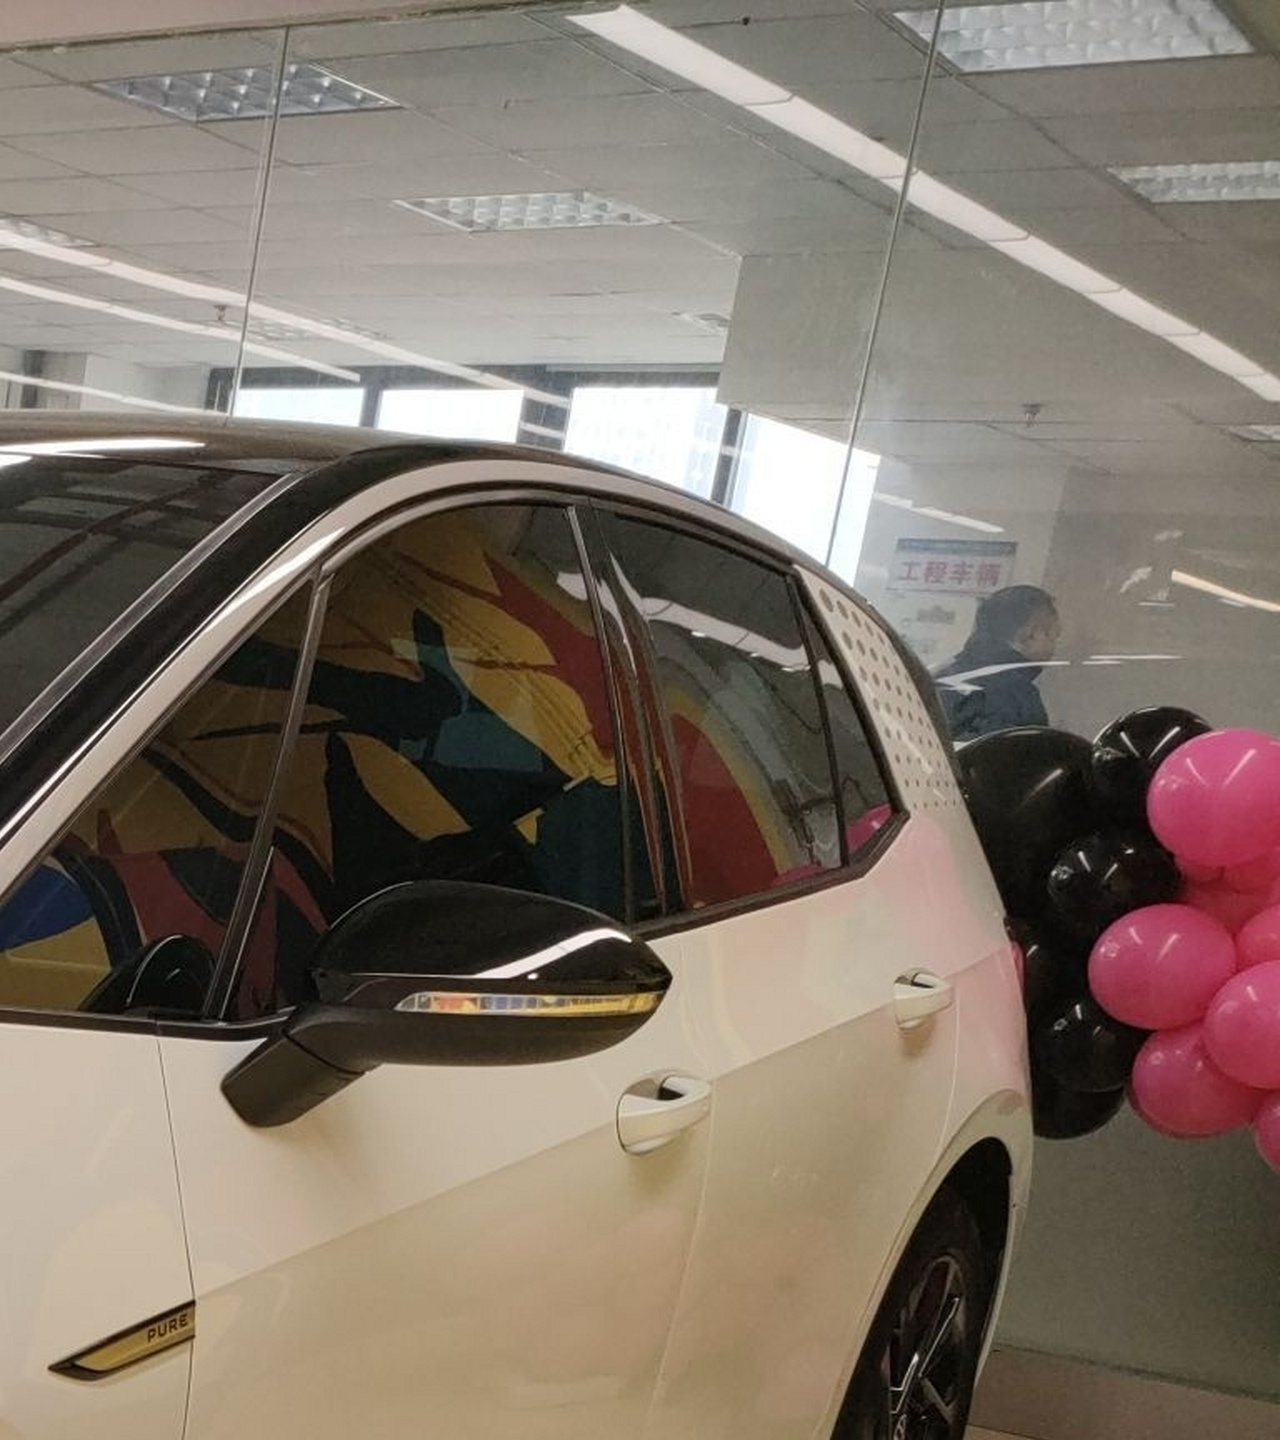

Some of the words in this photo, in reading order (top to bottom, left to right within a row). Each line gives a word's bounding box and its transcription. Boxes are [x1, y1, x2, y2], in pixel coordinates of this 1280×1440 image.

[898, 561, 1002, 587] 工程车辆
[146, 1313, 188, 1342] PURE
